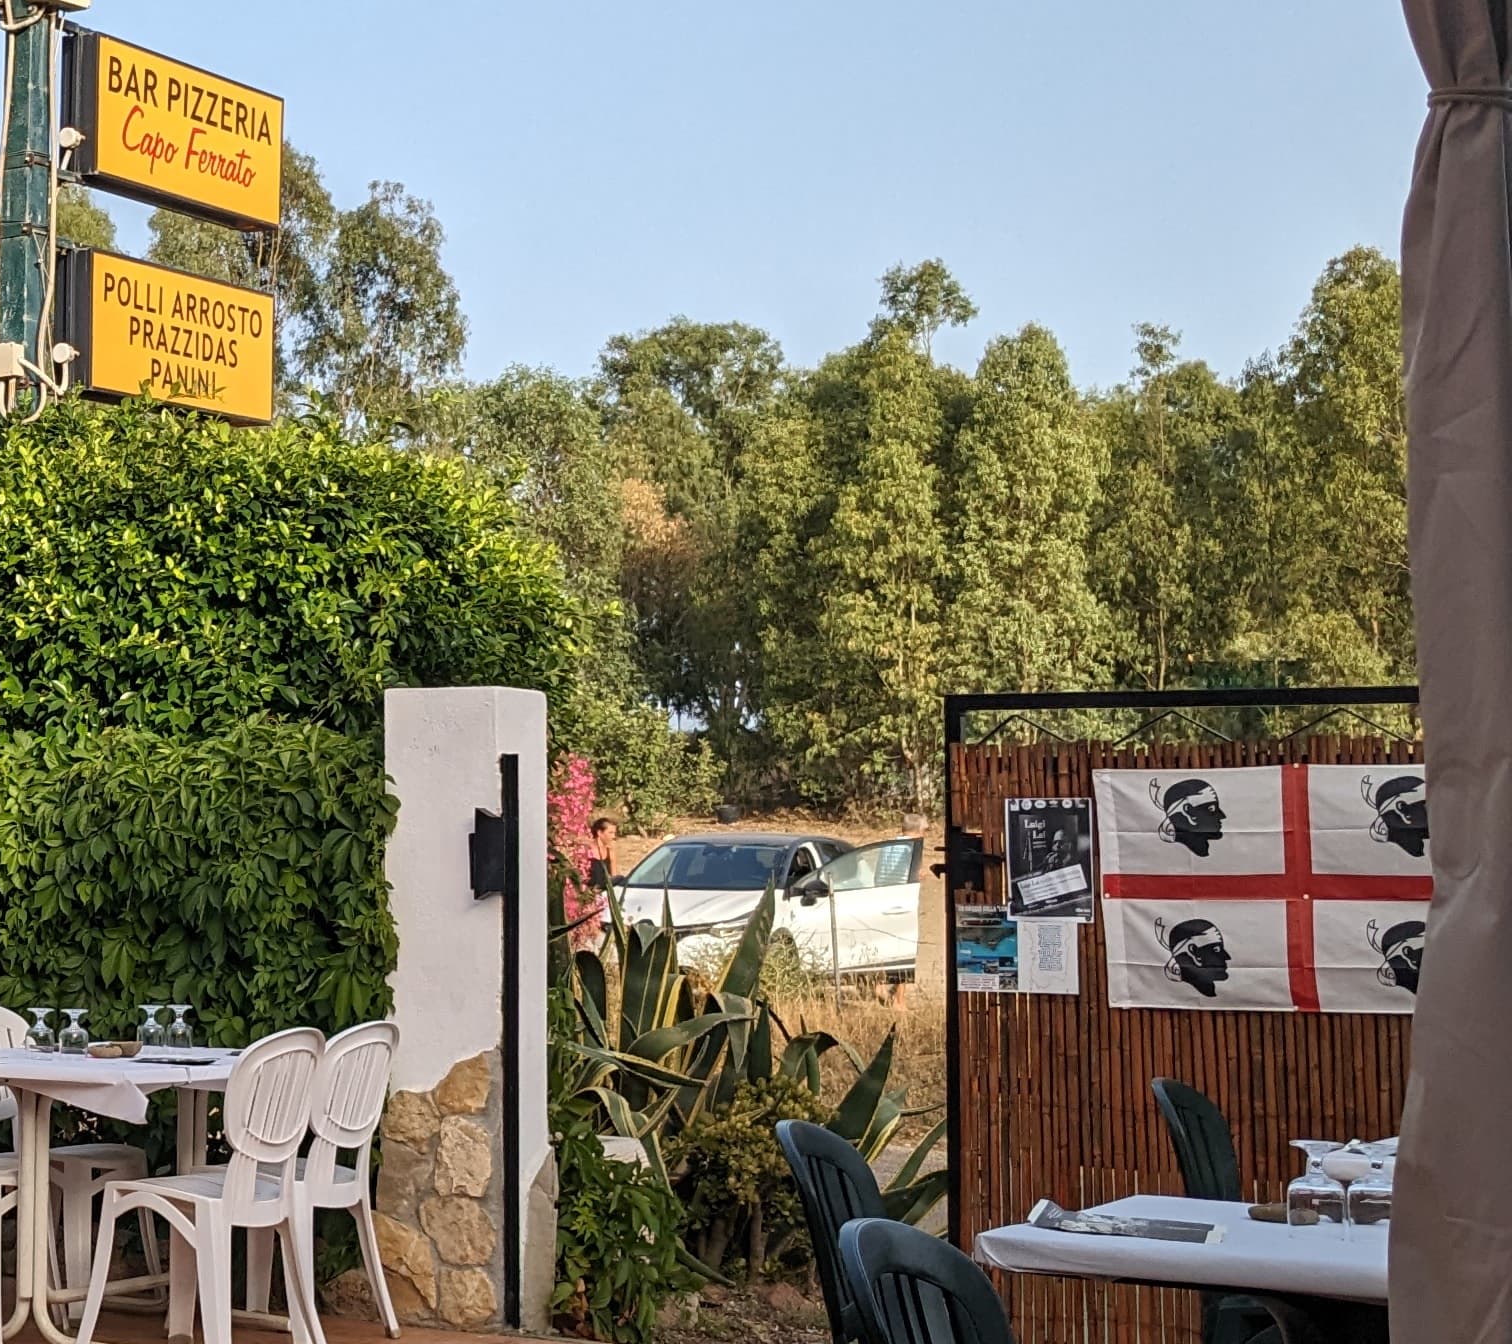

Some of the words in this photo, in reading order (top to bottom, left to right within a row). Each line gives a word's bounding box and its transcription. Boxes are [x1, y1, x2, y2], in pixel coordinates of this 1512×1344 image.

[108, 55, 158, 108] BAR
[167, 77, 272, 146] PIZZERIA
[122, 104, 179, 174] Capo
[184, 127, 257, 188] Ferrato
[104, 272, 163, 316] POLLI
[171, 290, 263, 338] ARROSTO
[129, 316, 238, 368] PRAZZIDAS
[151, 358, 216, 400] PANINI
